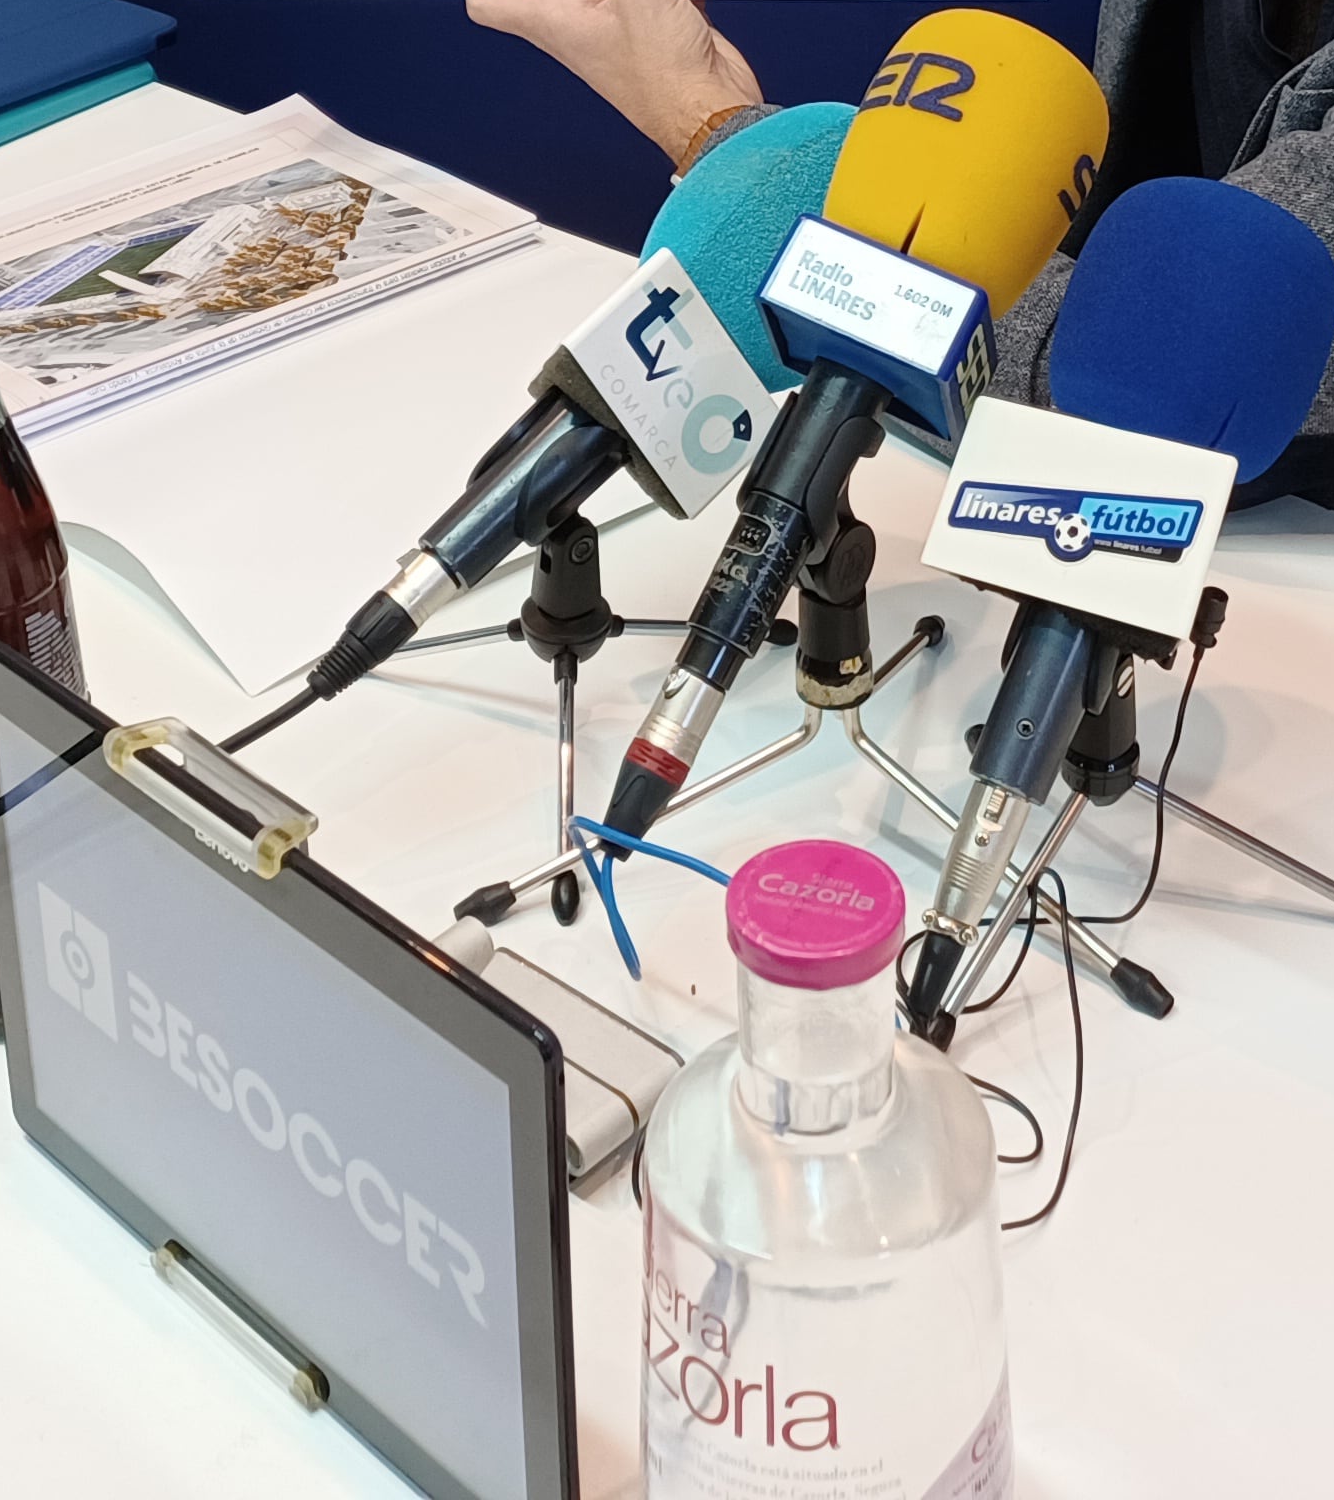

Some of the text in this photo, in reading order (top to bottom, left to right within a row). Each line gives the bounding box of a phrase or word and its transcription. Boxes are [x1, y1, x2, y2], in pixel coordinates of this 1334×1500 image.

[797, 248, 853, 287] Radio
[788, 270, 876, 321] LINARES
[600, 364, 678, 472] COMARCA
[955, 492, 1191, 537] linares fútbol
[758, 873, 875, 912] Cazorla
[128, 969, 489, 1330] BESOCCER
